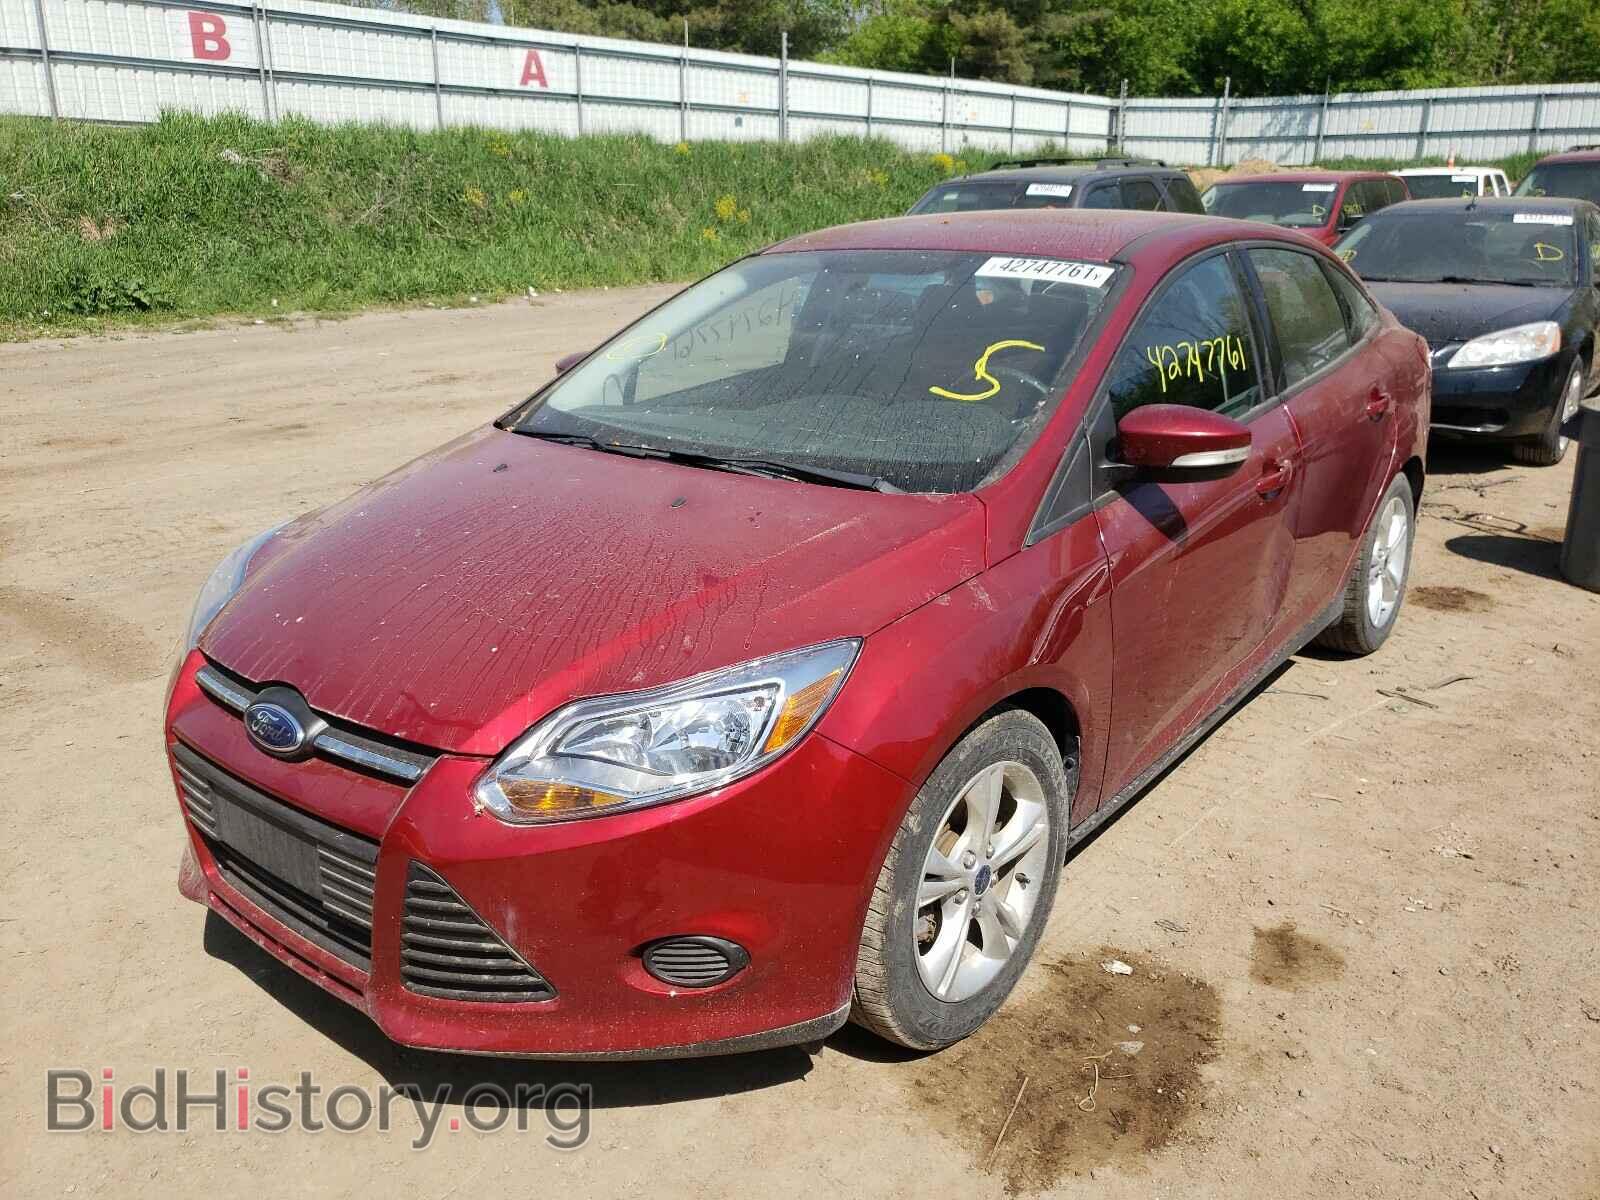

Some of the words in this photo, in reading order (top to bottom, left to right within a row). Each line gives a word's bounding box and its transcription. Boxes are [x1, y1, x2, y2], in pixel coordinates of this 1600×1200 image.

[188, 11, 231, 60] B
[519, 48, 548, 88] A
[999, 258, 1095, 280] 42747761
[1534, 242, 1564, 261] D
[928, 339, 1046, 401] S
[1146, 335, 1247, 393] 42747761
[250, 710, 291, 739] Ford
